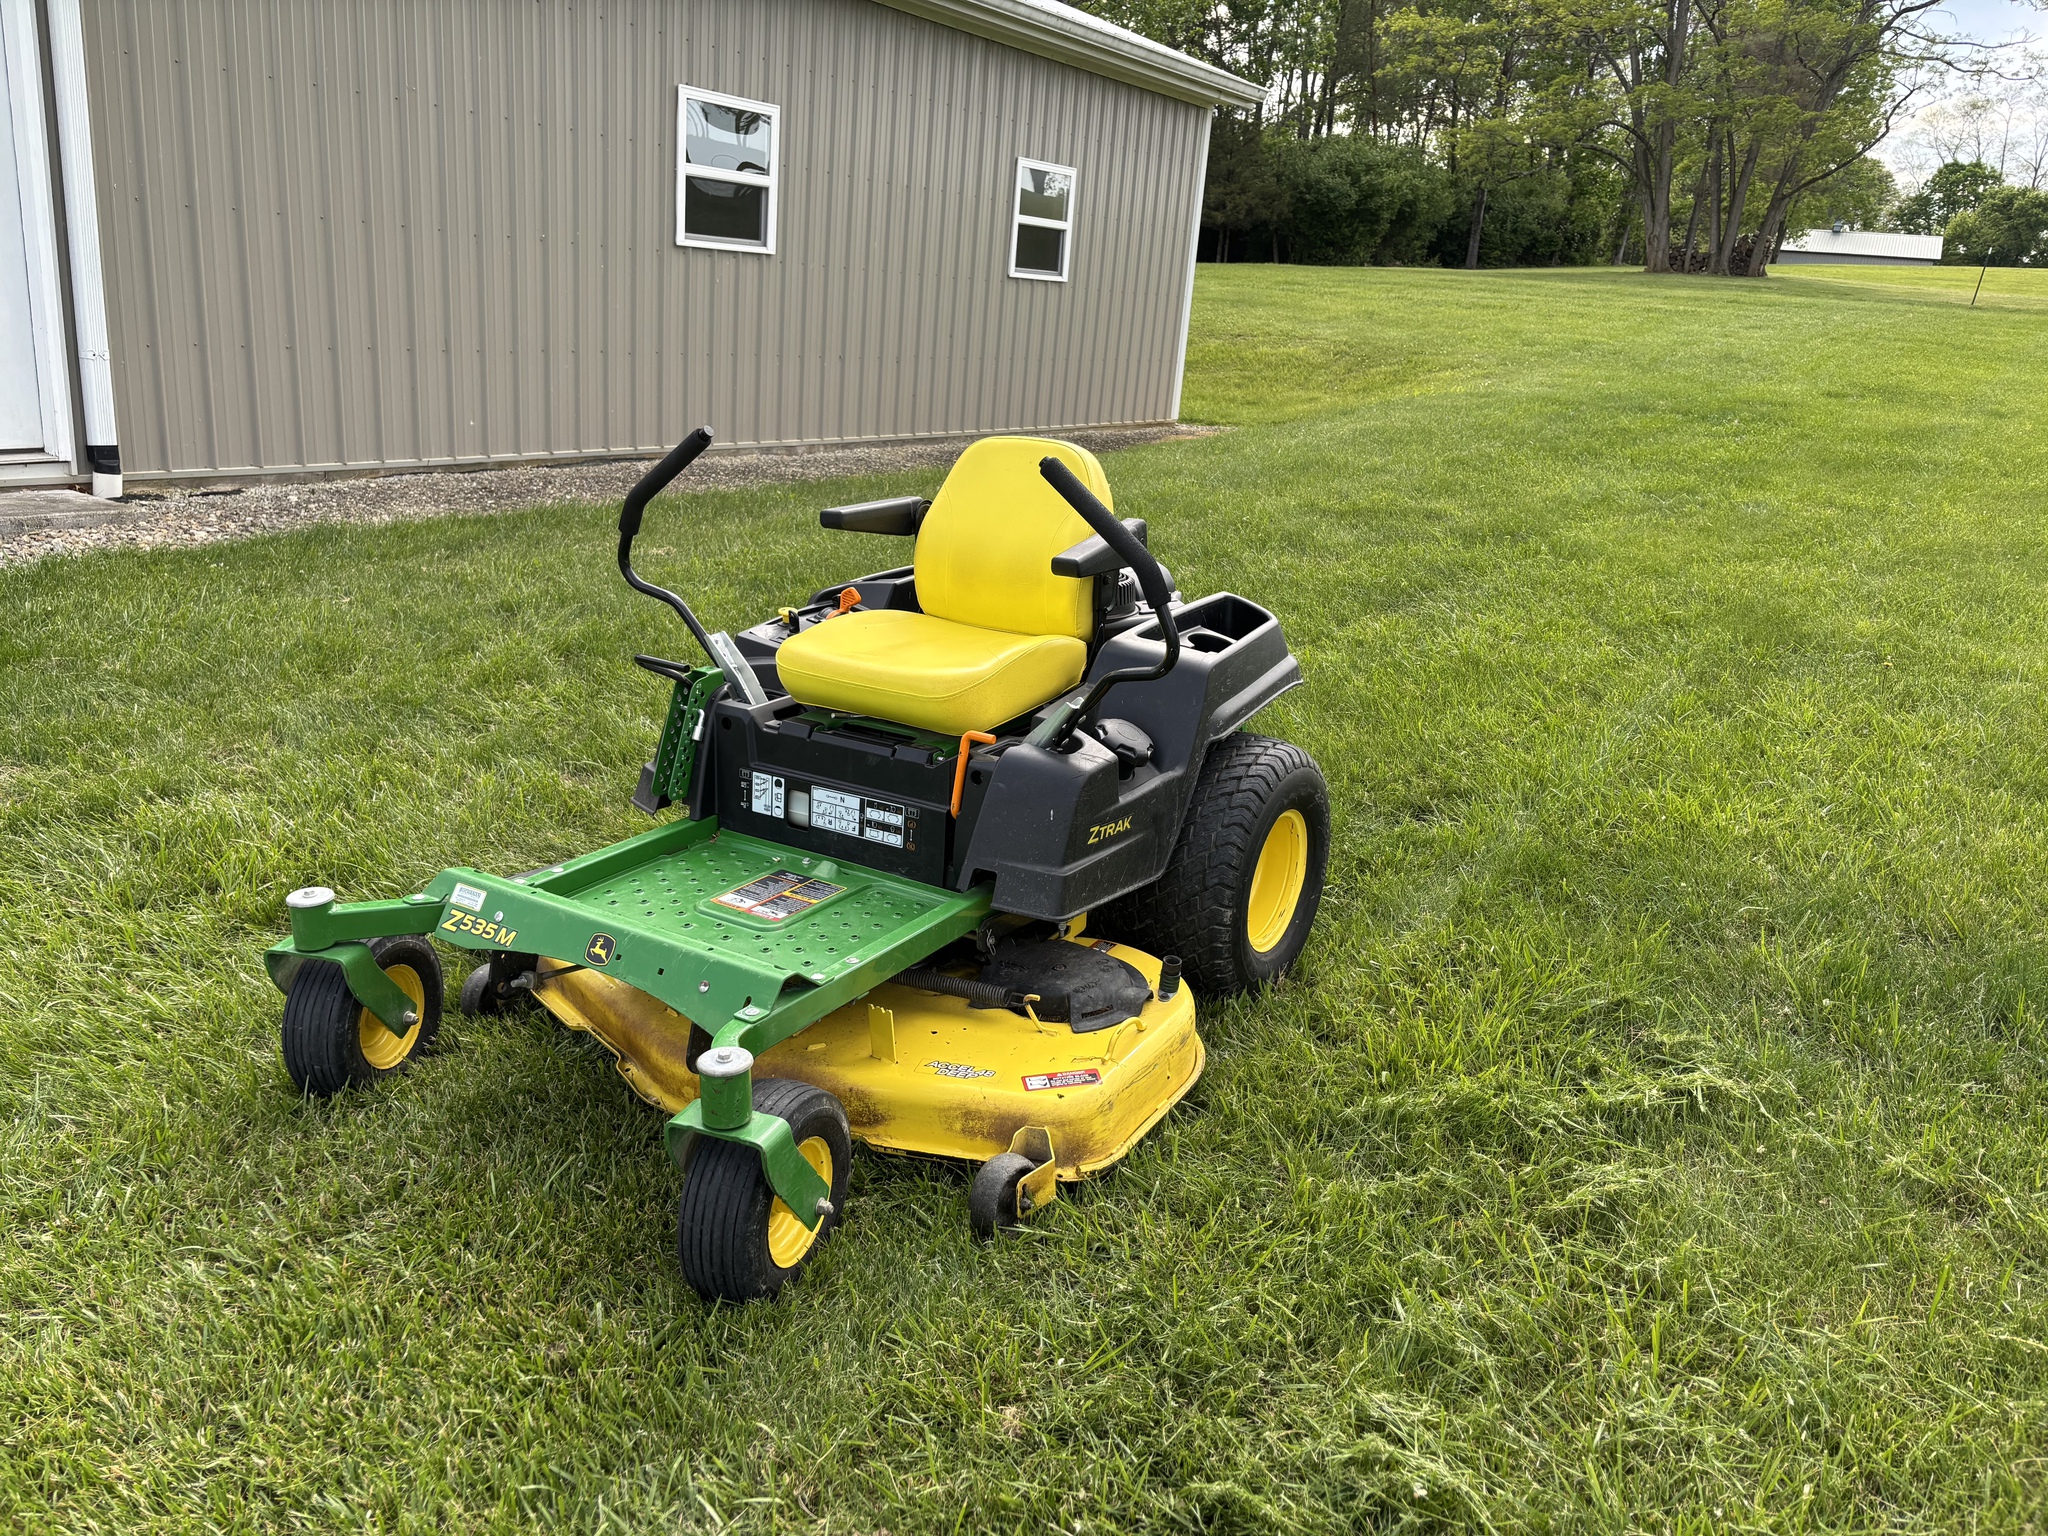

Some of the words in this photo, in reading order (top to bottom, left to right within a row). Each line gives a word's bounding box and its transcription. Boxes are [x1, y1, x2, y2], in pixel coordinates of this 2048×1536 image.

[1087, 815, 1133, 845] ZTRAK
[441, 908, 518, 948] Z535M
[924, 1060, 976, 1073] ACCEL
[975, 1069, 997, 1077] 48
[935, 1068, 979, 1079] DEEP
